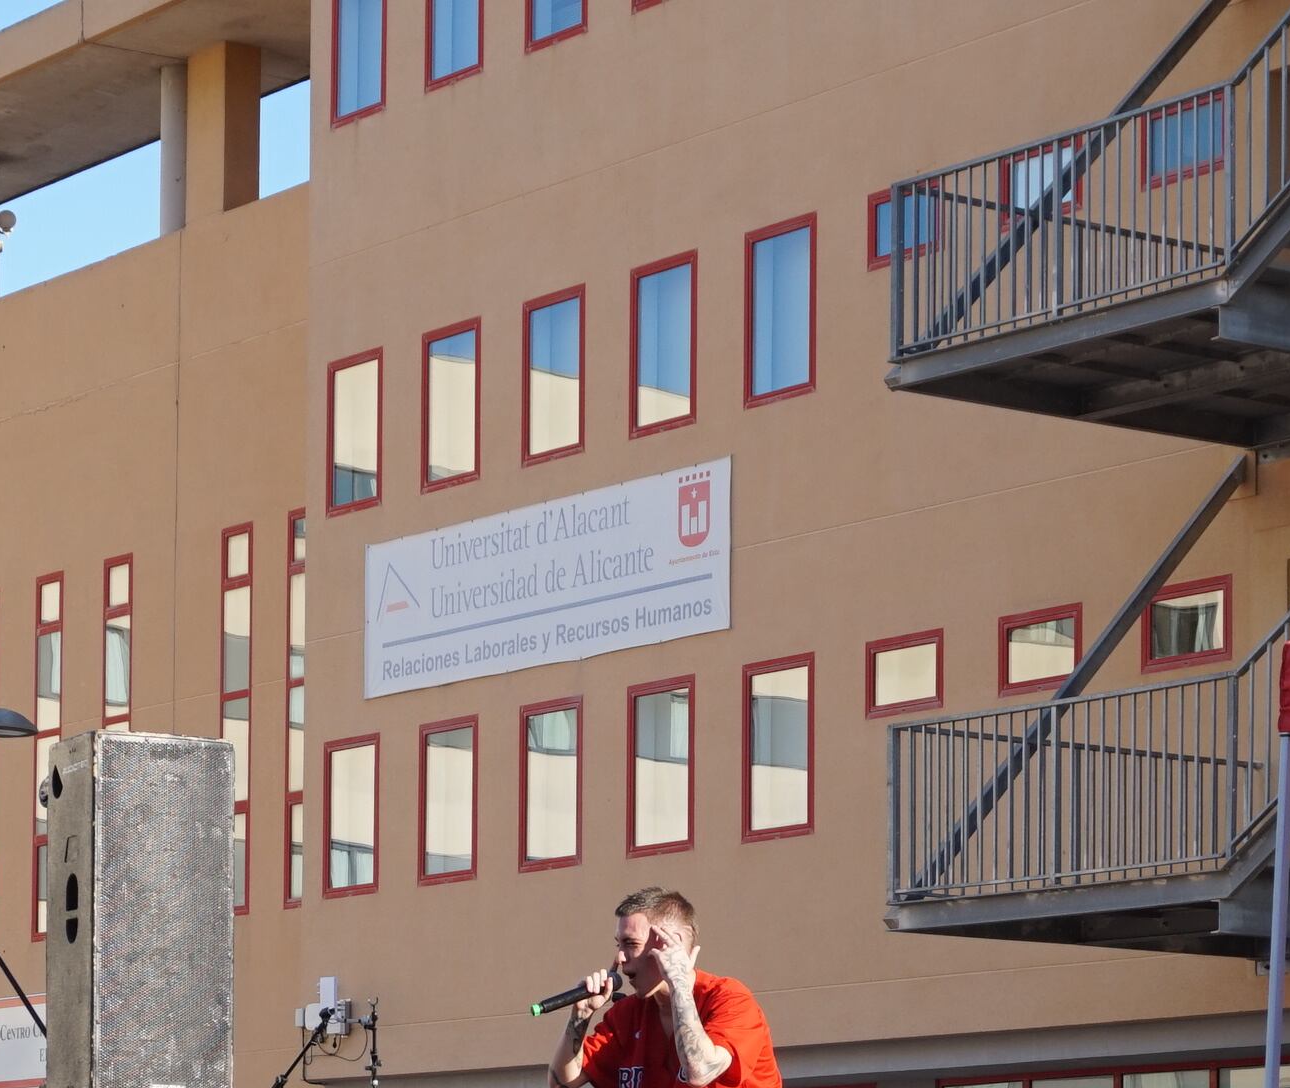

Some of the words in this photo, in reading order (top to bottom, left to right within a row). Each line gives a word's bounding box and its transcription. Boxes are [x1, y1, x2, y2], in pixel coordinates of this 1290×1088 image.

[431, 520, 530, 570] Universitat
[536, 495, 630, 545] d'Alacant
[431, 563, 538, 619] Universidad
[545, 559, 566, 594] de
[573, 544, 654, 588] Alicante
[382, 650, 460, 681] Relaciones
[465, 633, 537, 664] Laborales
[542, 631, 551, 653] y
[556, 615, 630, 646] Recursos
[636, 598, 713, 629] Humanos
